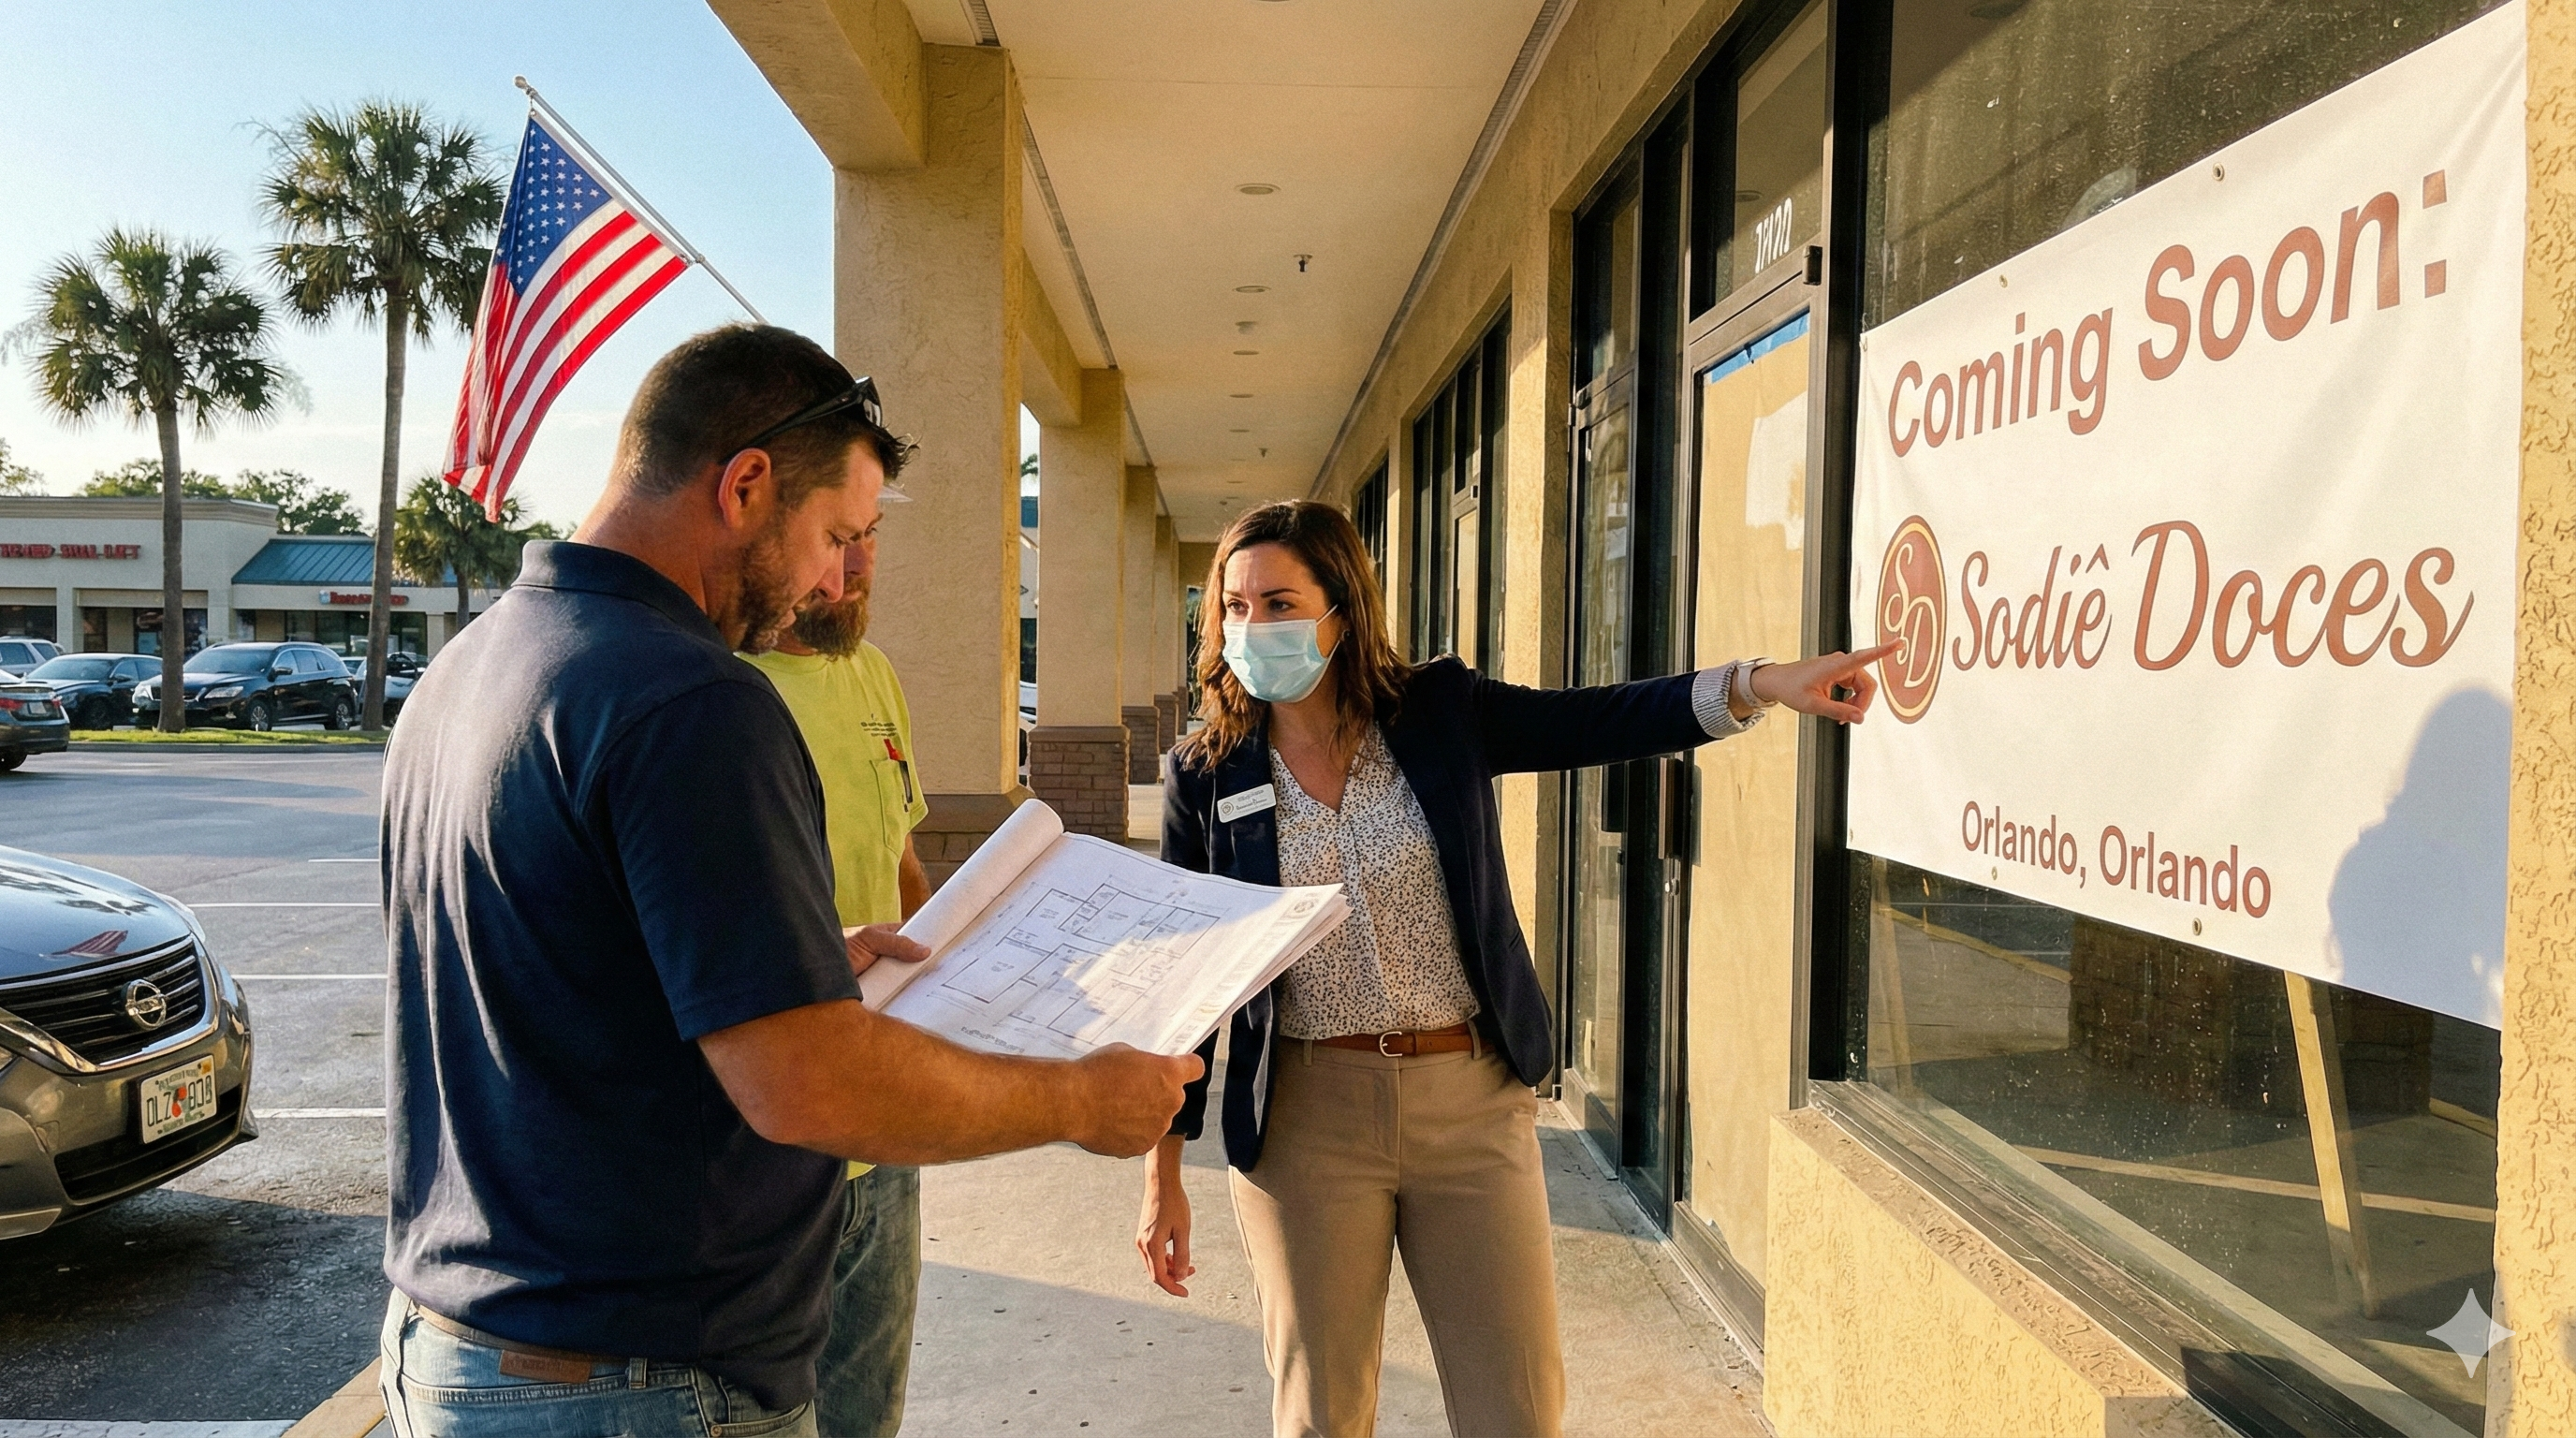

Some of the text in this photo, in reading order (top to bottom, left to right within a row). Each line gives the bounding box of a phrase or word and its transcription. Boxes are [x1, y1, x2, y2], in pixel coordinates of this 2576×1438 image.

[1887, 169, 2447, 458] Coming Soon:
[1952, 520, 2475, 672] Sodiê Doces
[1962, 800, 2273, 918] Orlando, Orlando
